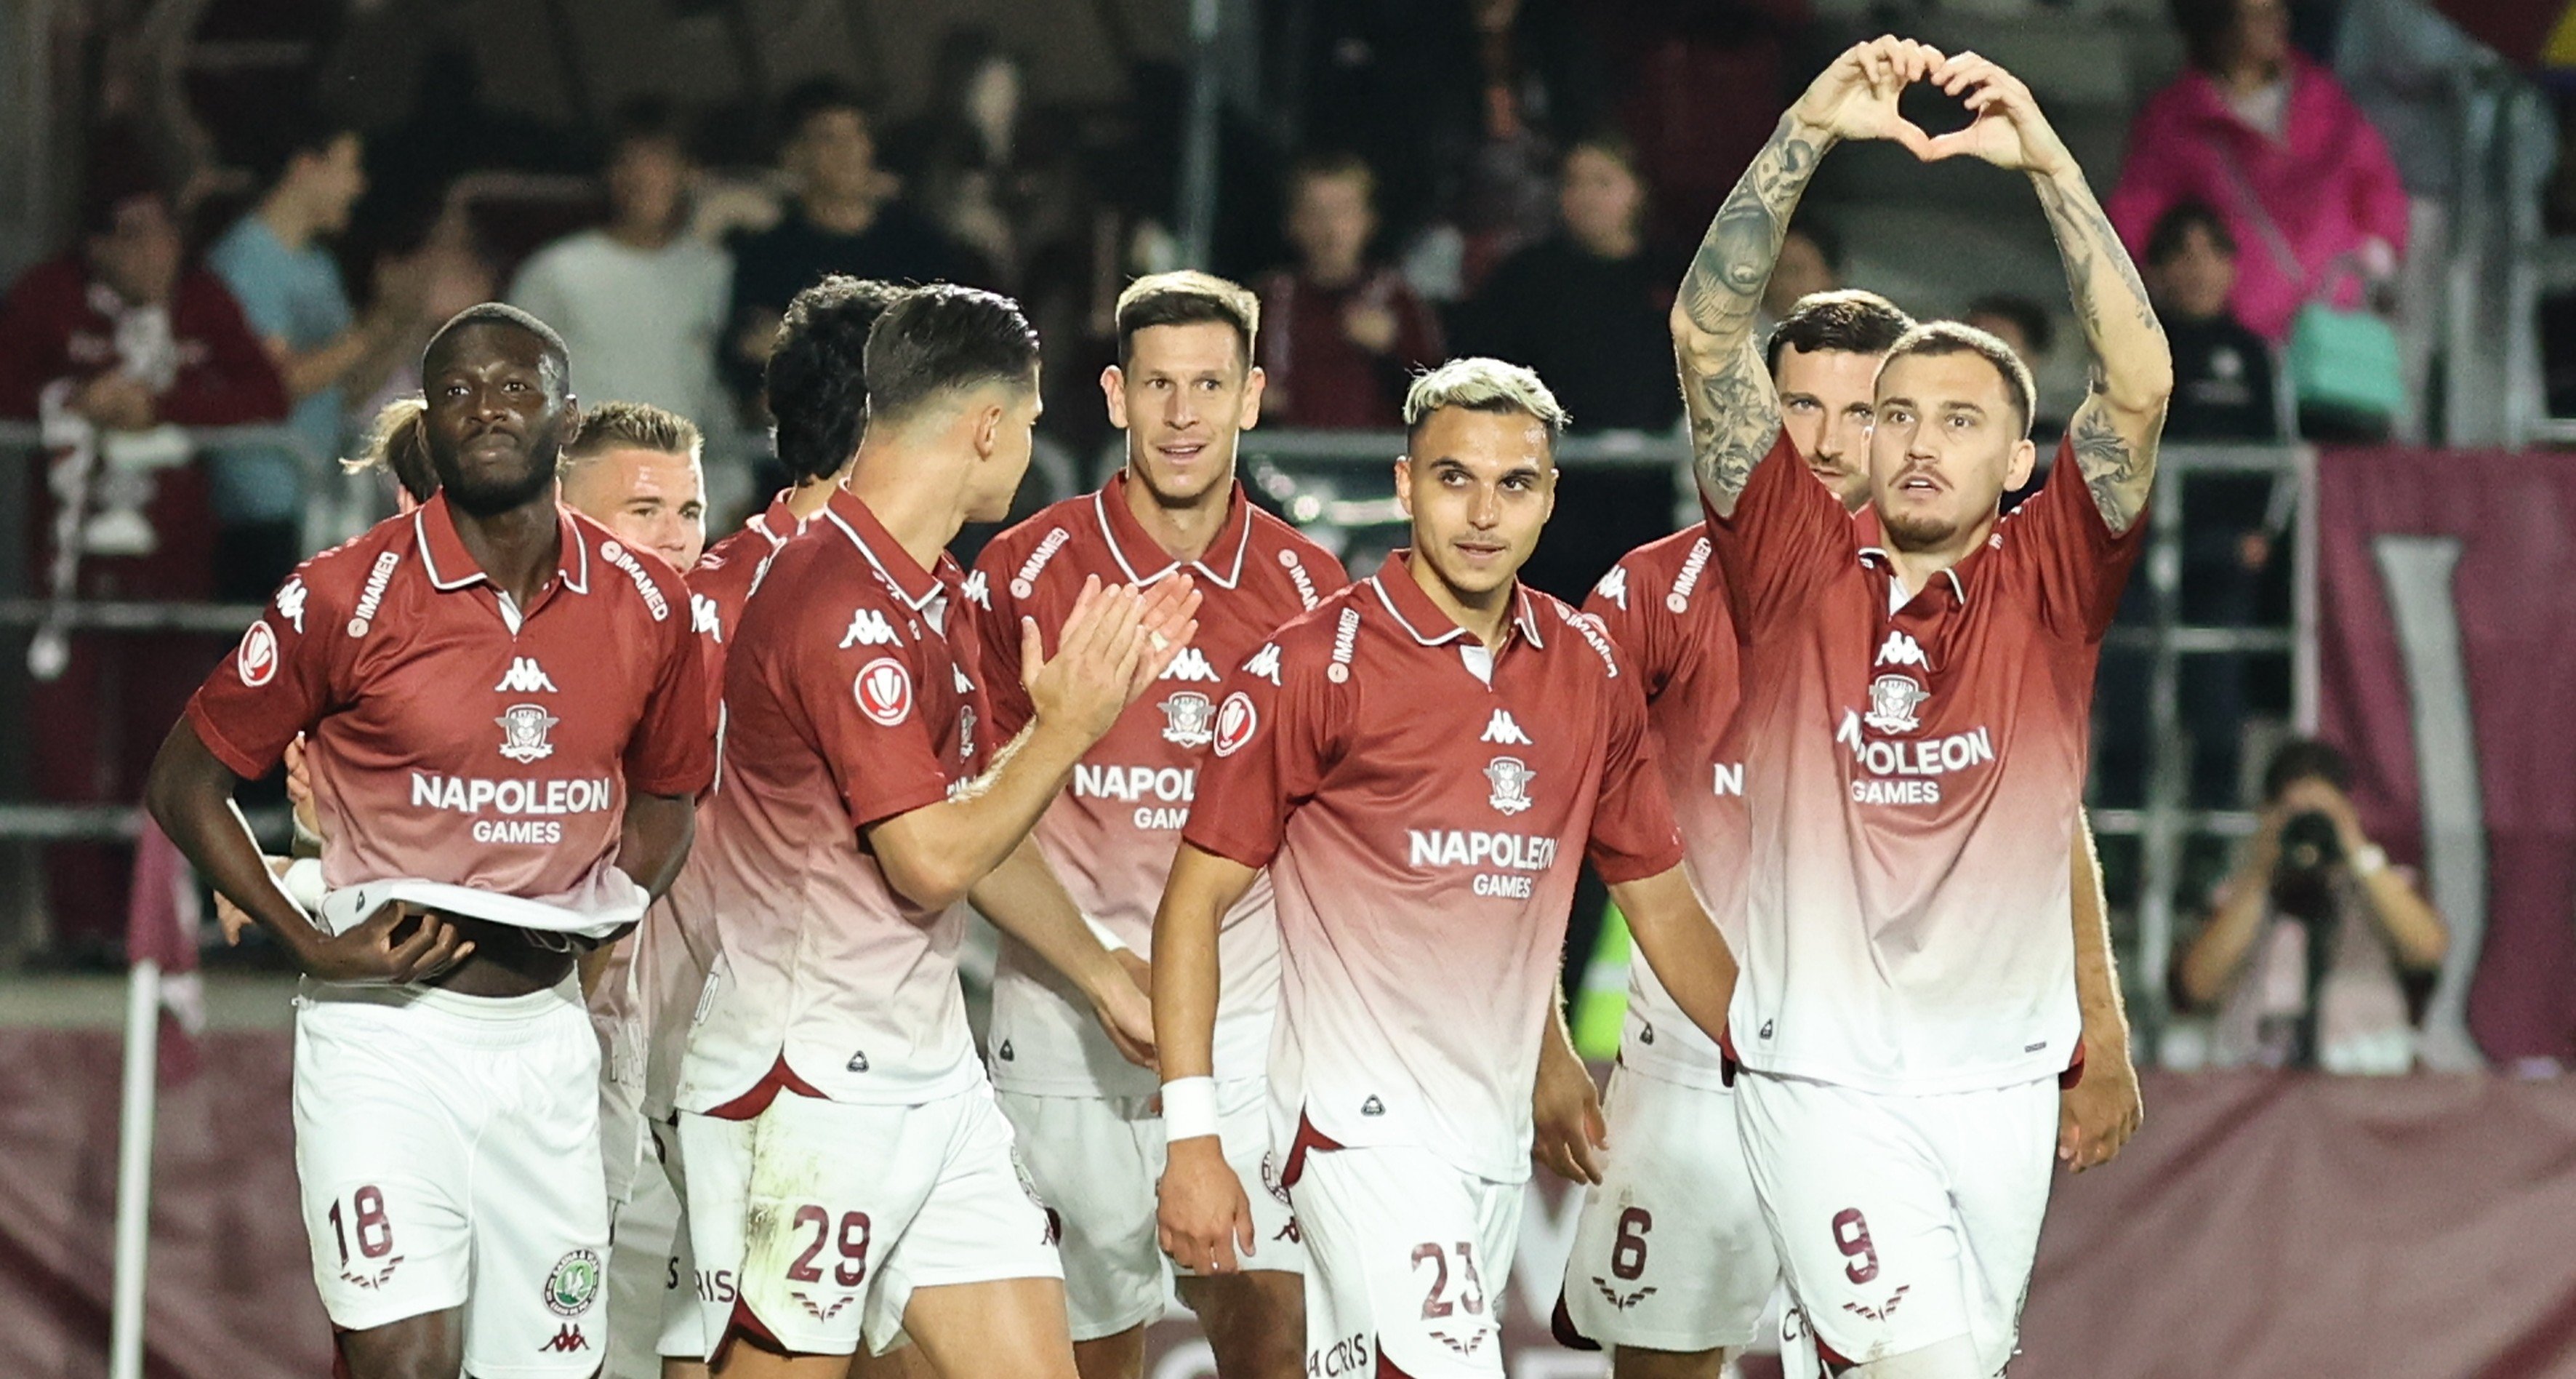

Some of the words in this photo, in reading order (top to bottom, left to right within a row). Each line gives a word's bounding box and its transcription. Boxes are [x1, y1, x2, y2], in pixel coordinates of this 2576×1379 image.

[1019, 527, 1069, 581] IMAMED
[1673, 537, 1712, 597] IMAMED
[358, 551, 398, 620] IMAMED
[617, 552, 670, 622] IMAMED
[1333, 607, 1359, 663] IMAMED
[412, 772, 609, 813] NAPOLEON
[1075, 764, 1194, 801] NAPOL
[1851, 780, 1940, 804] GAMES
[473, 820, 561, 844] GAMES
[1134, 807, 1187, 829] GAM
[1409, 829, 1557, 870] NAPOLEON
[1474, 874, 1530, 898] GAMES
[328, 1185, 393, 1266] 18
[786, 1204, 871, 1287] 29
[1611, 1207, 1653, 1281] 6
[1831, 1207, 1879, 1285] 9
[1411, 1242, 1485, 1321] 23
